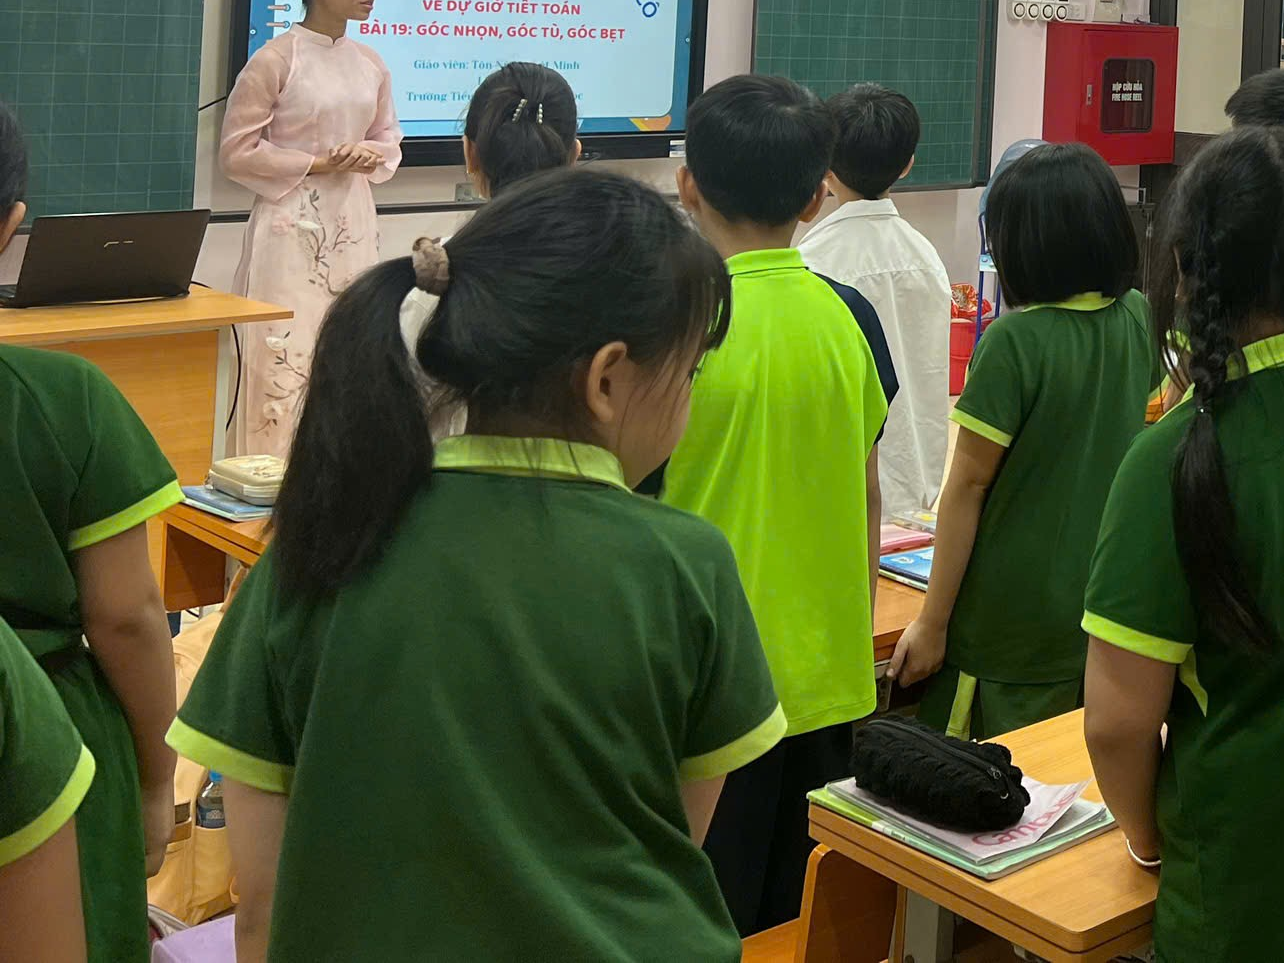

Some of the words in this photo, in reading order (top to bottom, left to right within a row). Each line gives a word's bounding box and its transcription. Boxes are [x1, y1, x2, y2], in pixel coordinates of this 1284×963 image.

[447, 0, 471, 15] DỰ
[542, 0, 580, 15] TOÁN
[360, 19, 387, 35] BÀI
[391, 24, 412, 35] 19:
[417, 21, 450, 36] GÓC
[454, 25, 503, 40] NHỌN,
[507, 23, 538, 37] GÓC
[541, 23, 564, 40] TÙ,
[567, 24, 597, 38] GÓC
[600, 28, 626, 43] BẸT
[413, 59, 439, 69] Giáo
[554, 60, 580, 70] Minh
